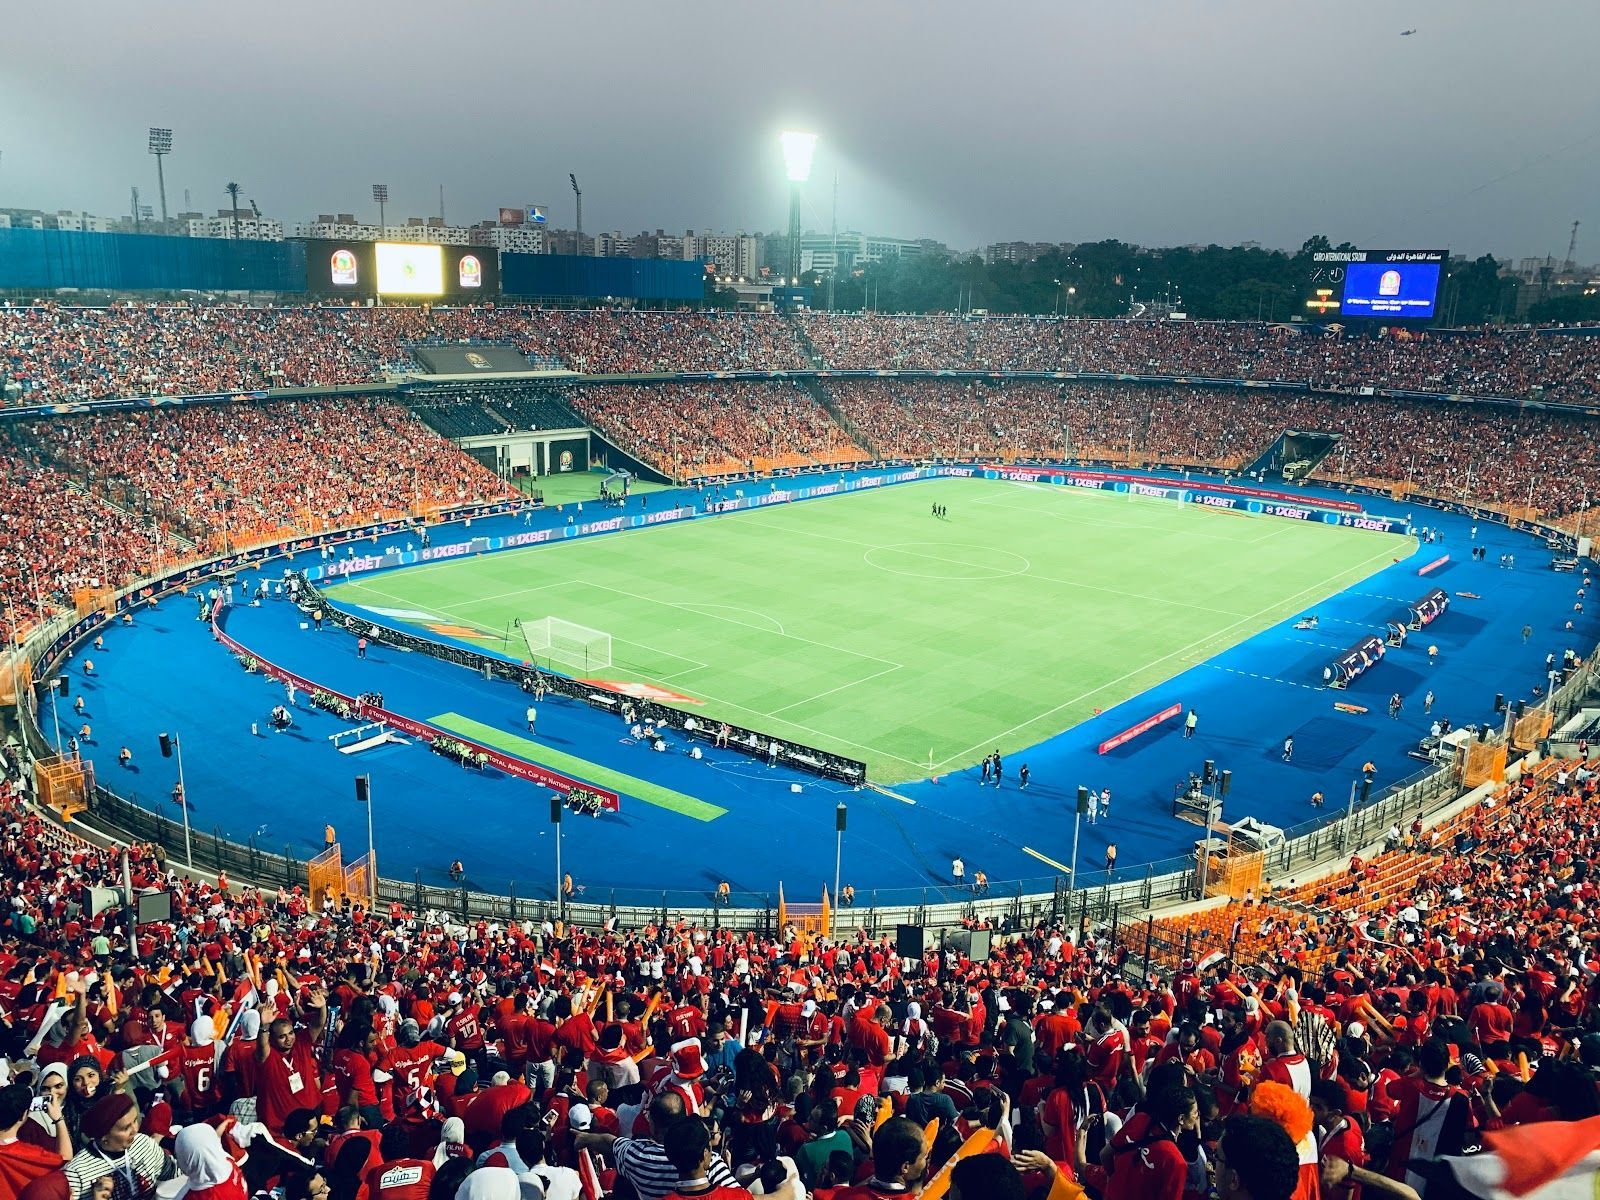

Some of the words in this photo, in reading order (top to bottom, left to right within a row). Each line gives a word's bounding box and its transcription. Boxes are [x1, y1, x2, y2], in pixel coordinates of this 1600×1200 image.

[944, 466, 974, 477] 1XBET
[1009, 472, 1040, 482] 1XBET
[817, 484, 839, 495] 1XBET
[1075, 477, 1105, 489] 1XBET
[1203, 495, 1237, 509] 1XBET
[655, 508, 684, 522] 1XBET
[1275, 506, 1311, 520] 1XBET
[591, 517, 622, 533] 1XBET
[1353, 518, 1393, 532] 1XBET
[516, 529, 552, 544] 1XBET
[432, 542, 473, 558] 1XBET
[338, 556, 383, 573] 1XBET
[405, 723, 415, 732] CUP
[507, 763, 527, 775] AFRICA
[527, 770, 539, 779] CUP
[548, 778, 571, 791] NATIONS
[197, 1067, 210, 1092] 6
[407, 1068, 420, 1091] 5
